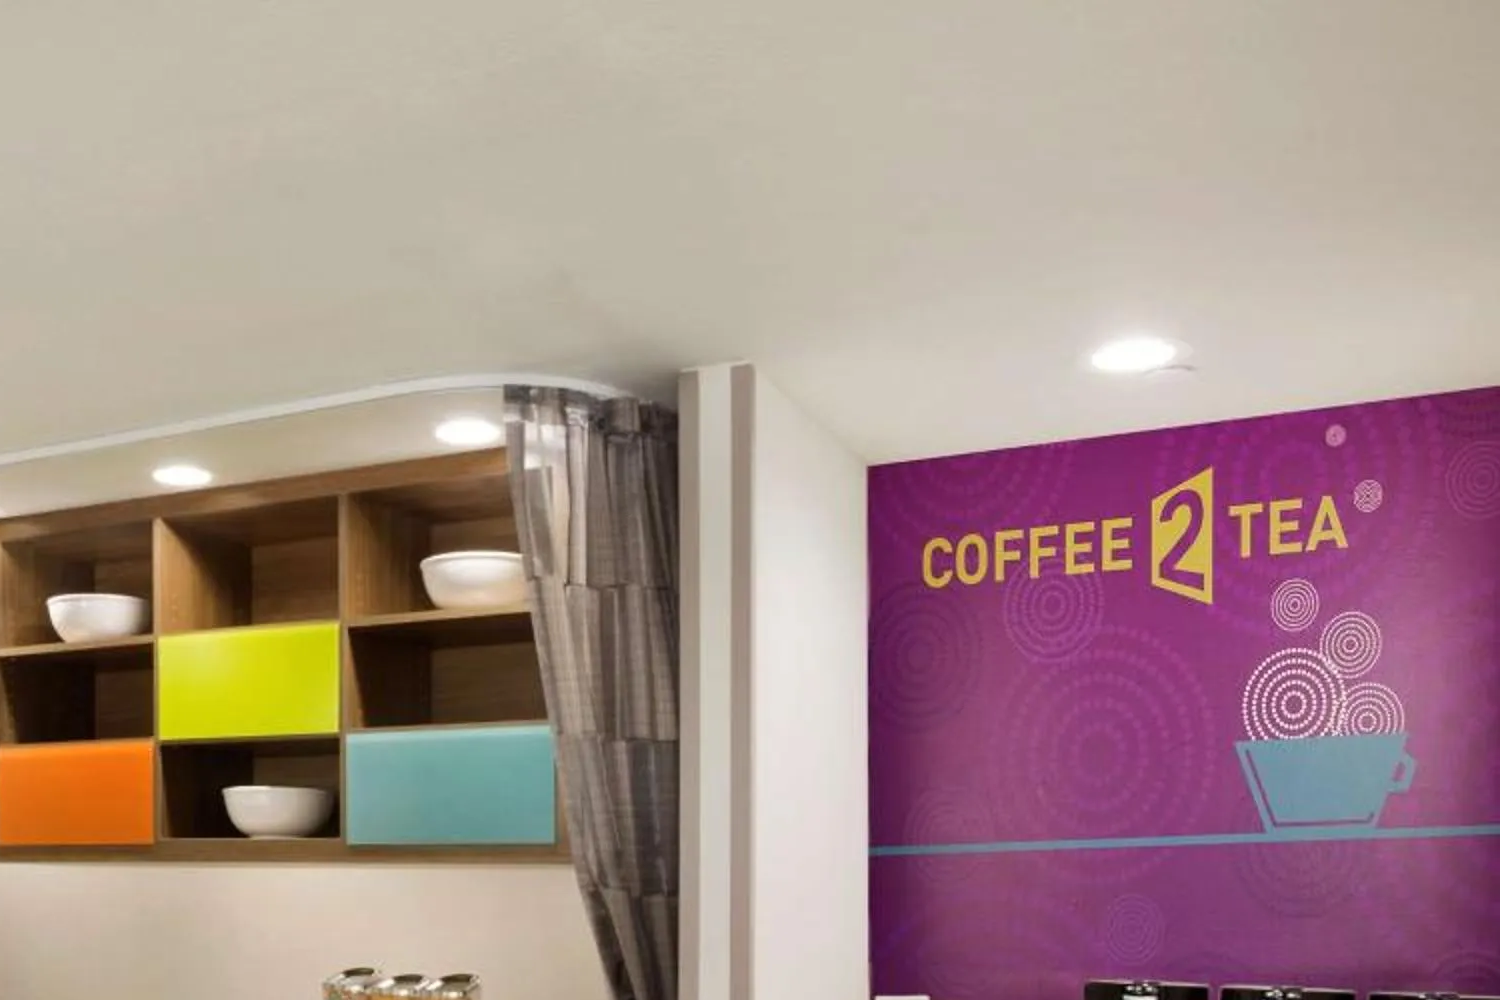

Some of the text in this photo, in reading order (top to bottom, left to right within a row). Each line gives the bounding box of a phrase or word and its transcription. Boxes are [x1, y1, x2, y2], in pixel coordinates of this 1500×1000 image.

[922, 484, 1349, 595] COFFEE 2 TEA
